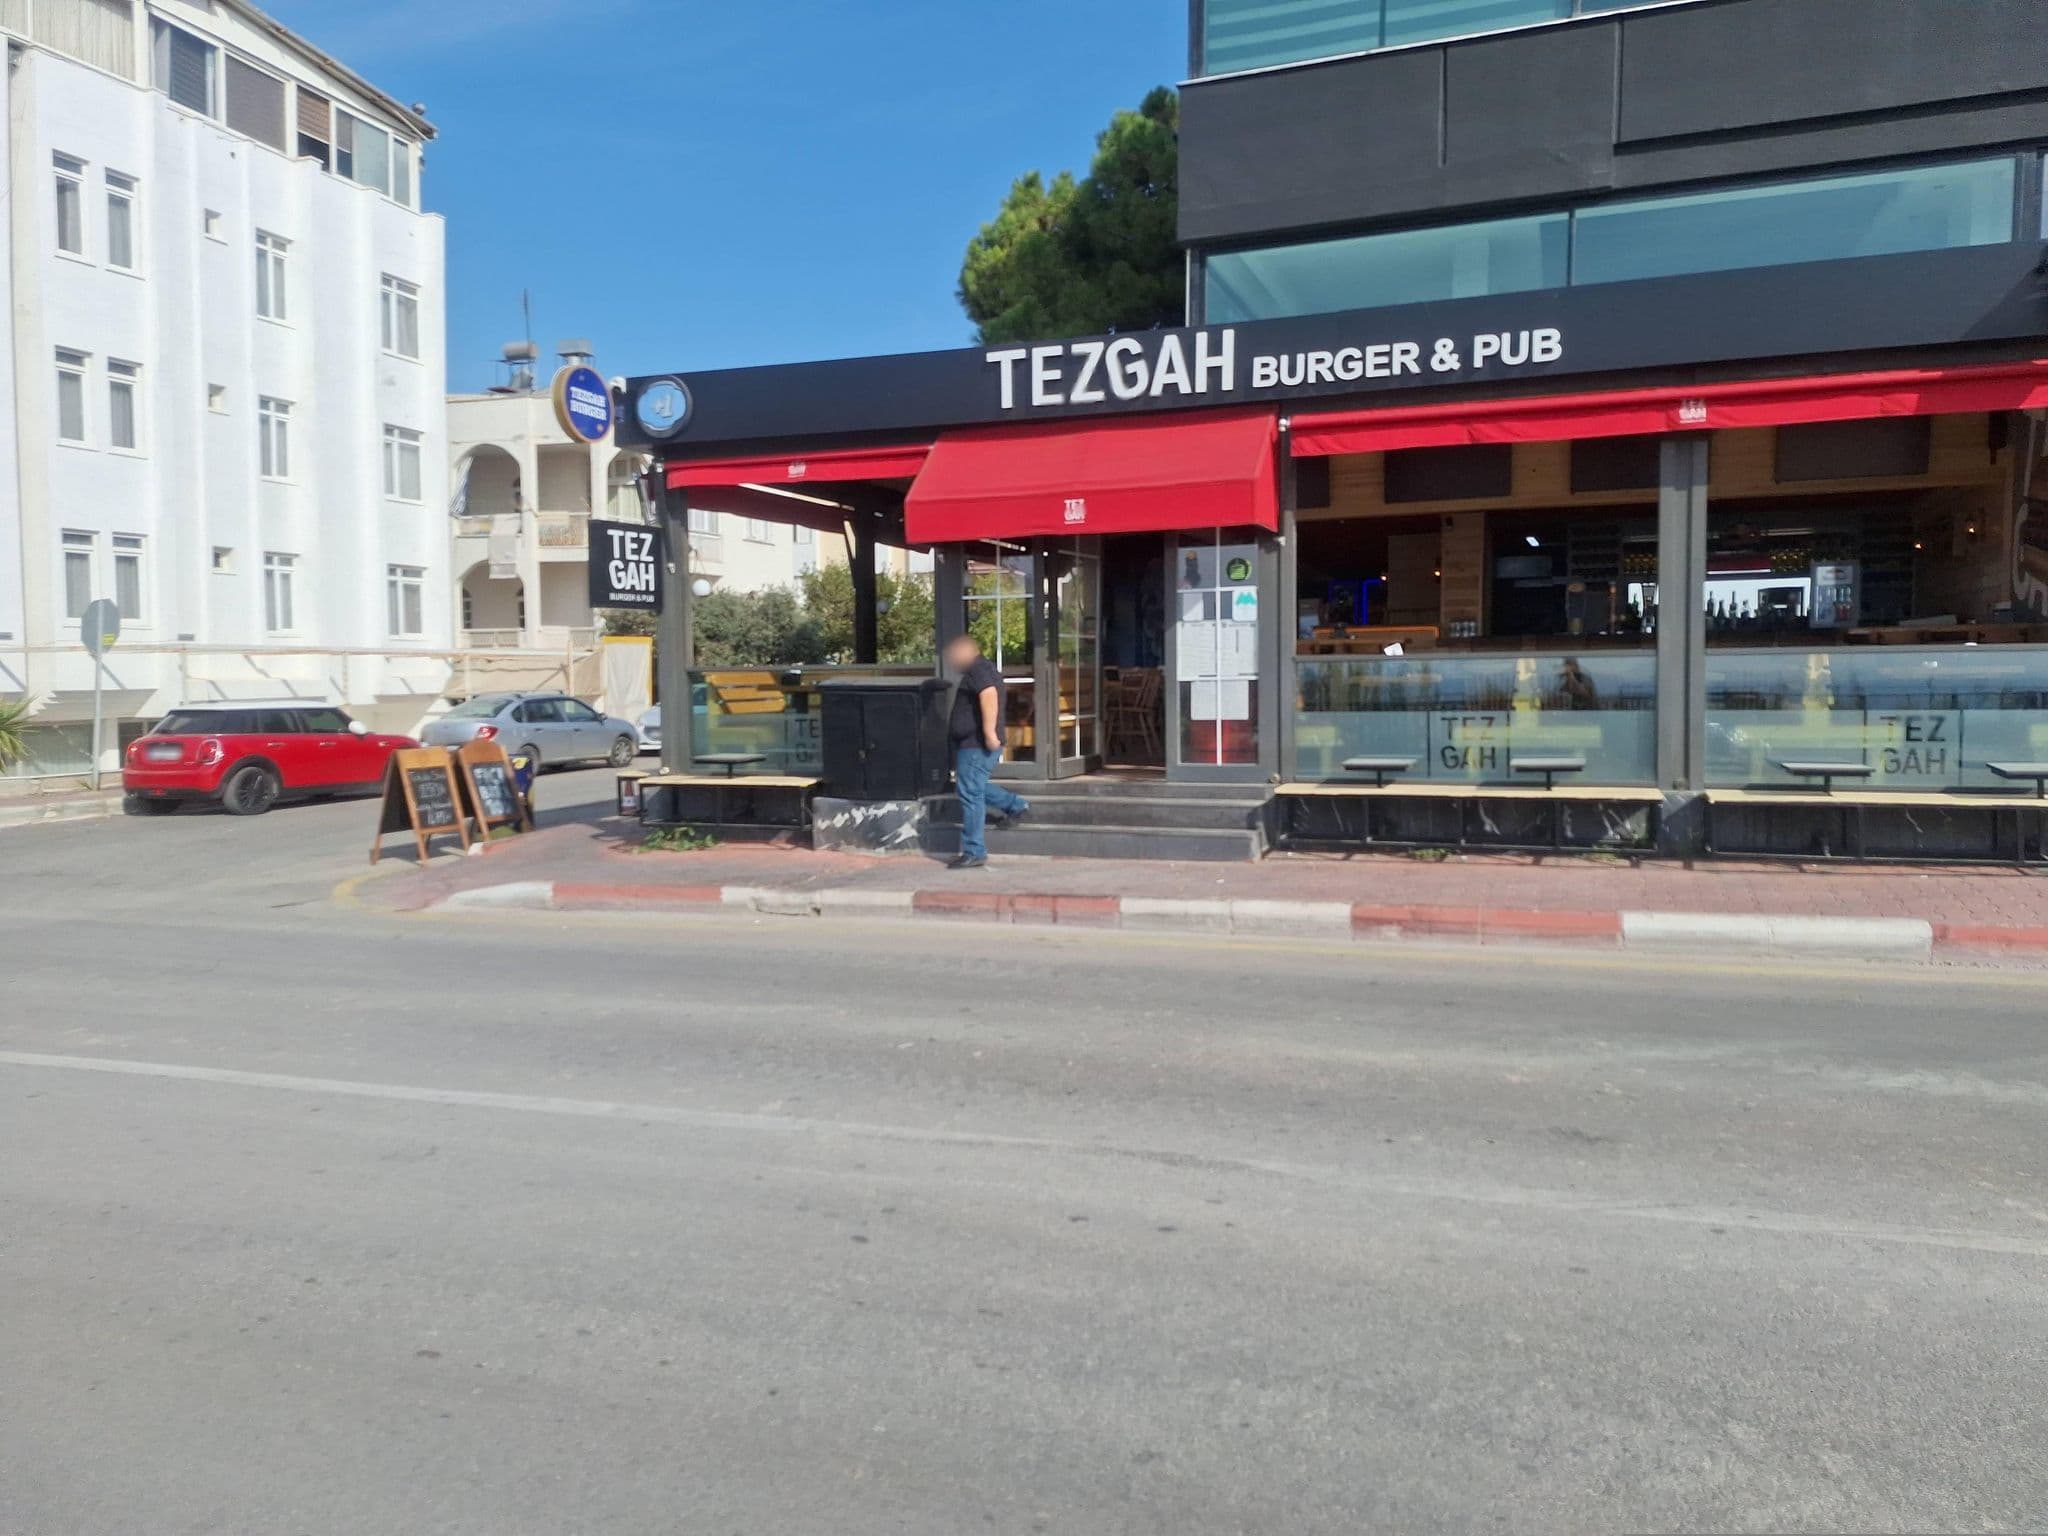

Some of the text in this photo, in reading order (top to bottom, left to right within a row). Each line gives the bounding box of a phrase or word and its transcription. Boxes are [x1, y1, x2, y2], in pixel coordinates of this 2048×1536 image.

[986, 328, 1563, 409] TEZGAH BURGER & PUB
[607, 529, 654, 562] TEZ
[608, 560, 655, 591] GAH
[1441, 716, 1496, 740] TEZ
[1880, 715, 1946, 741] TEZ
[1441, 745, 1496, 769] GAH
[1882, 747, 1946, 774] GAH
